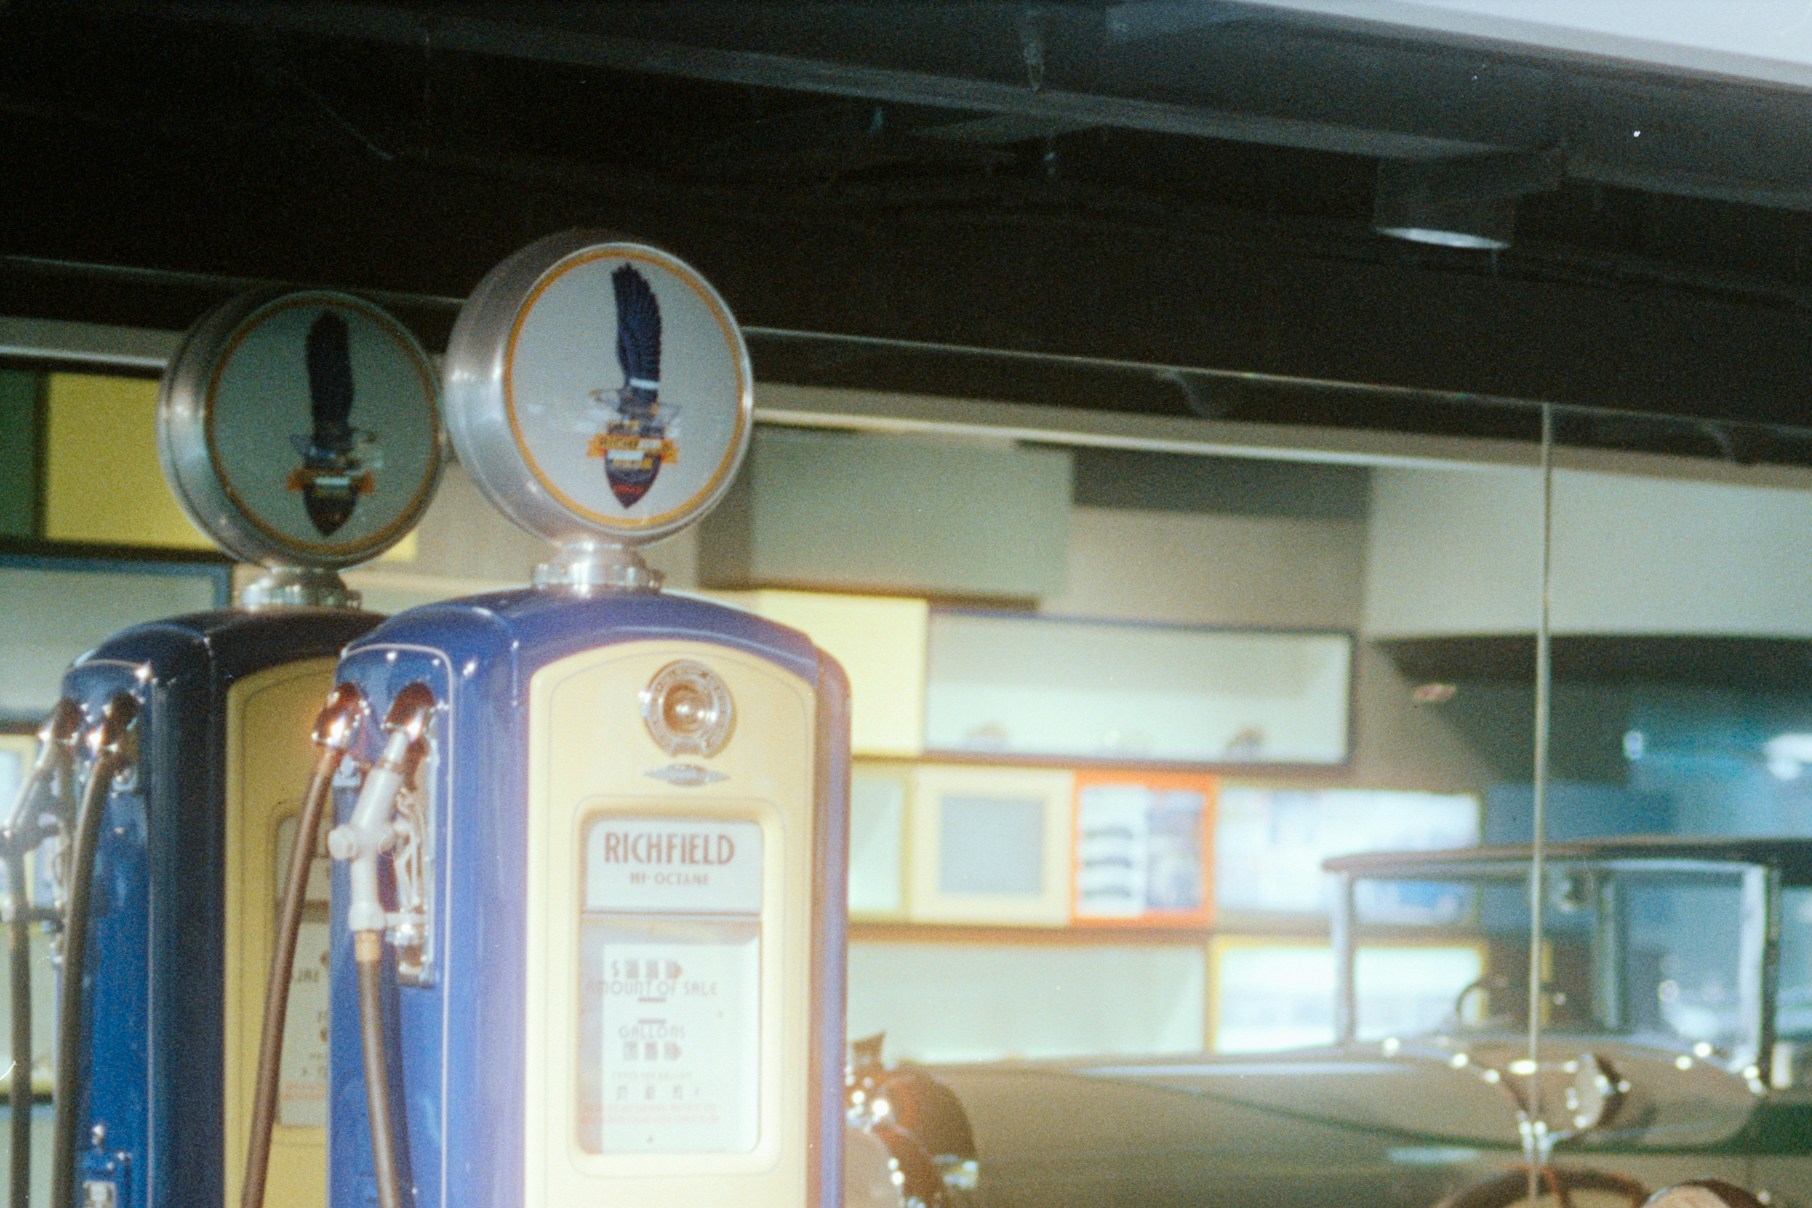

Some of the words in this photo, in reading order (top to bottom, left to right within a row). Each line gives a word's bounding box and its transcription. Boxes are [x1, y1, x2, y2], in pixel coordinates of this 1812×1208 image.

[604, 831, 736, 865] RICHFIELD
[629, 871, 710, 886] HI-OCTANE
[656, 979, 675, 996] OF
[683, 980, 717, 996] SALE
[617, 1023, 686, 1040] GALLONS
